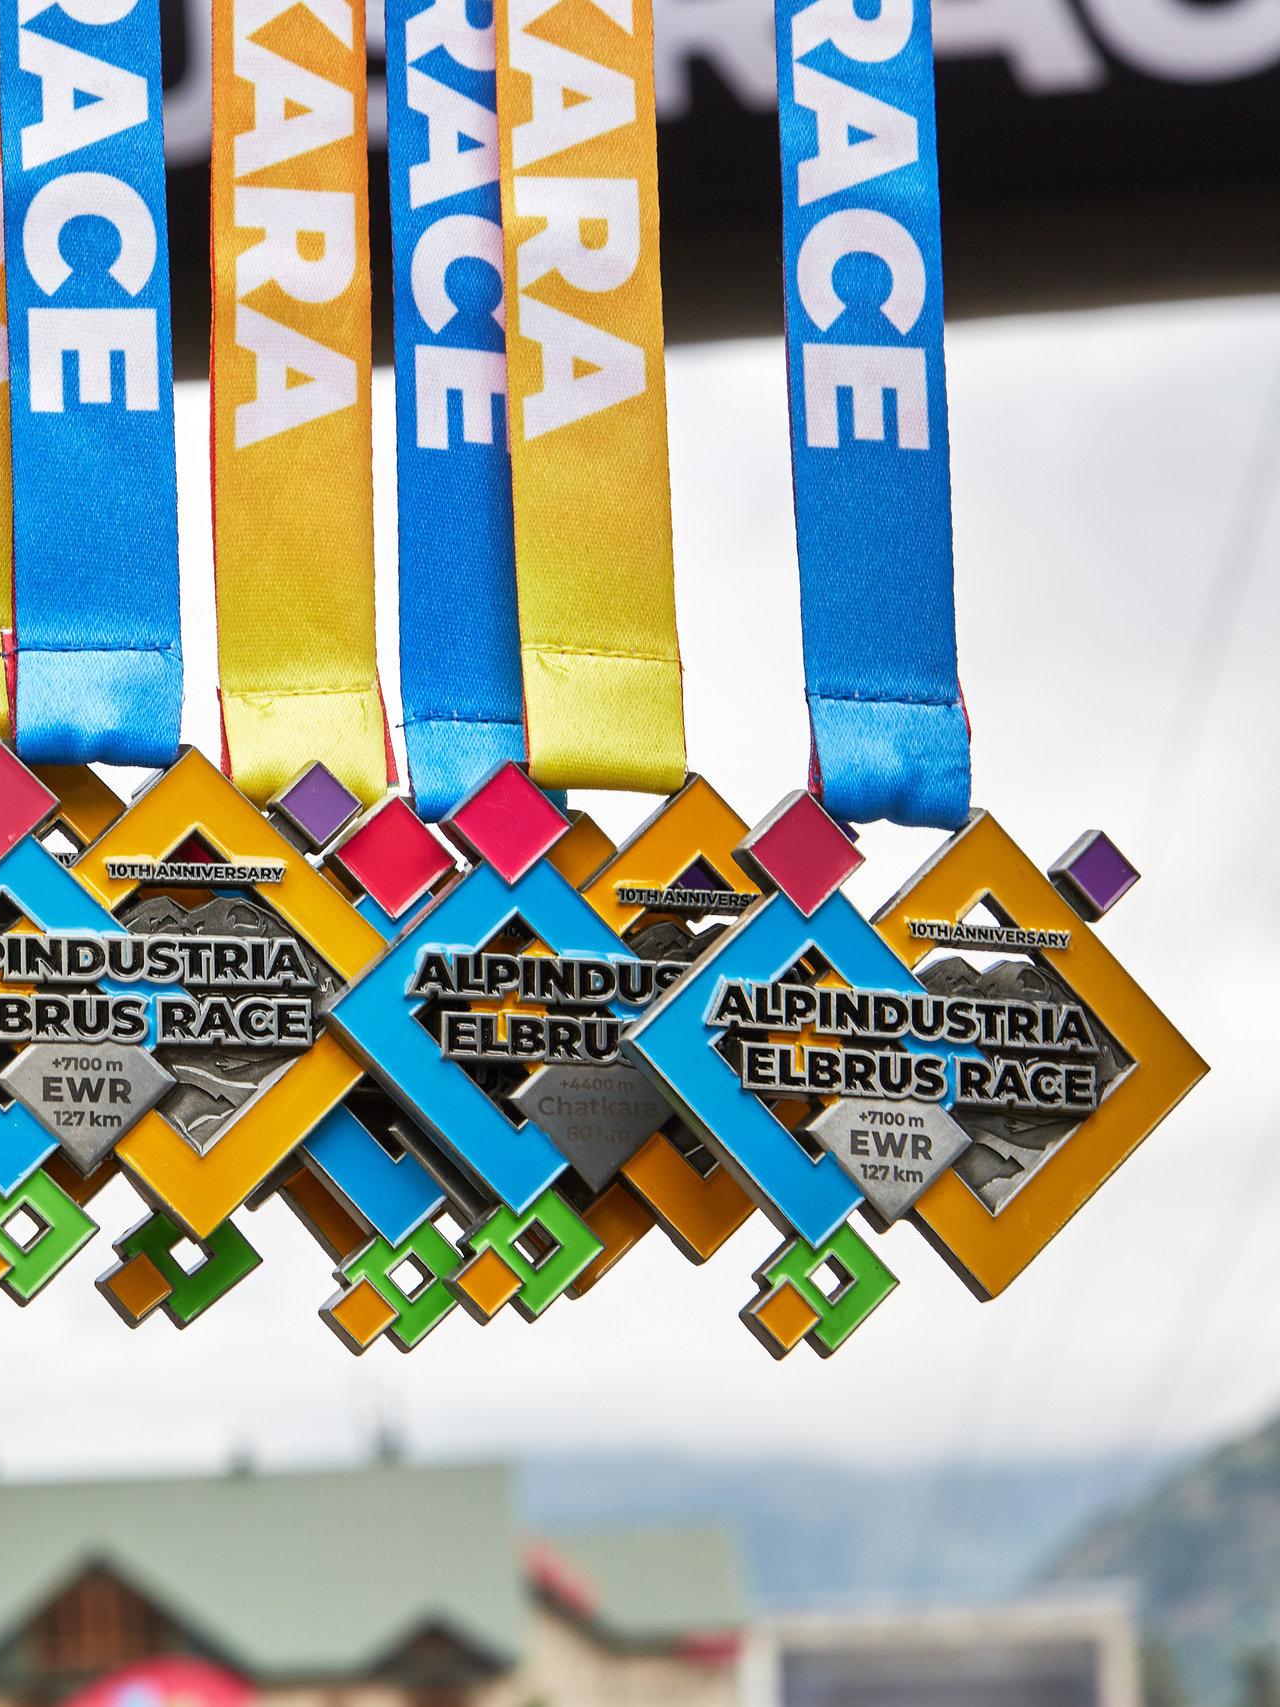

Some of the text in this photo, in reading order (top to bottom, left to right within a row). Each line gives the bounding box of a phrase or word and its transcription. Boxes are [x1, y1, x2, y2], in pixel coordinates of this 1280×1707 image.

[18, 0, 160, 413] ACE
[107, 863, 286, 884] 10TH ANNIVERSARY
[618, 888, 660, 905] 10TH
[909, 922, 1070, 949] 10TH ANNIVERSARY
[157, 996, 313, 1049] RACE
[706, 979, 1099, 1053] ALPINDUSTRIA
[442, 1011, 637, 1066] ELBRU
[52, 1057, 123, 1072] +7100 m
[741, 1042, 1097, 1109] ELBRUS RACE
[43, 1077, 131, 1105] EWR
[54, 1110, 122, 1128] 127 km
[538, 1096, 658, 1119] Chatkara
[858, 1111, 924, 1128] +7100 m
[566, 1127, 632, 1143] 60 km
[850, 1130, 933, 1160] EWR
[860, 1164, 924, 1184] 127 km
